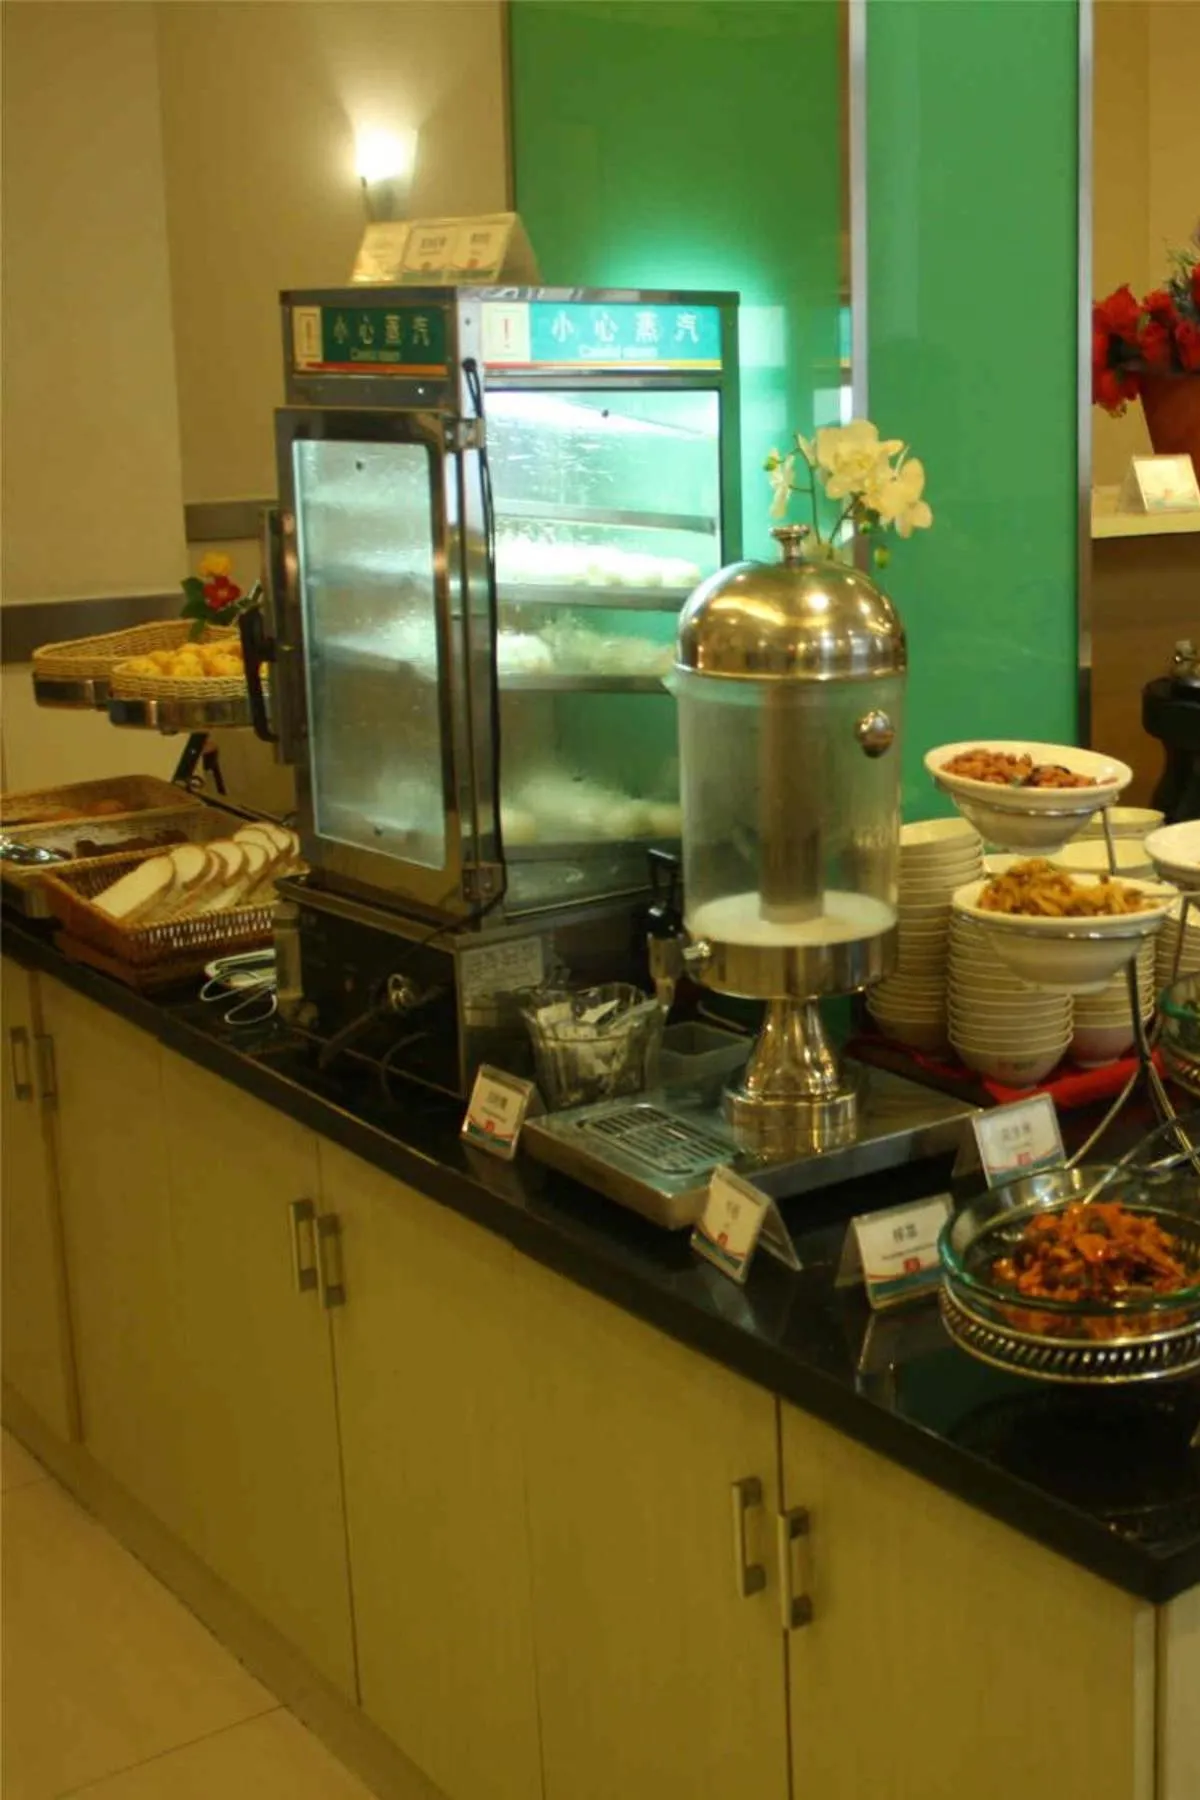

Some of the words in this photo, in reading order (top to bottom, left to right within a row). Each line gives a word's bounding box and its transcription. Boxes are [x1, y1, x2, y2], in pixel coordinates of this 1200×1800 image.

[333, 313, 430, 346] 小心蒸汽
[552, 309, 699, 343] 小心蒸汽
